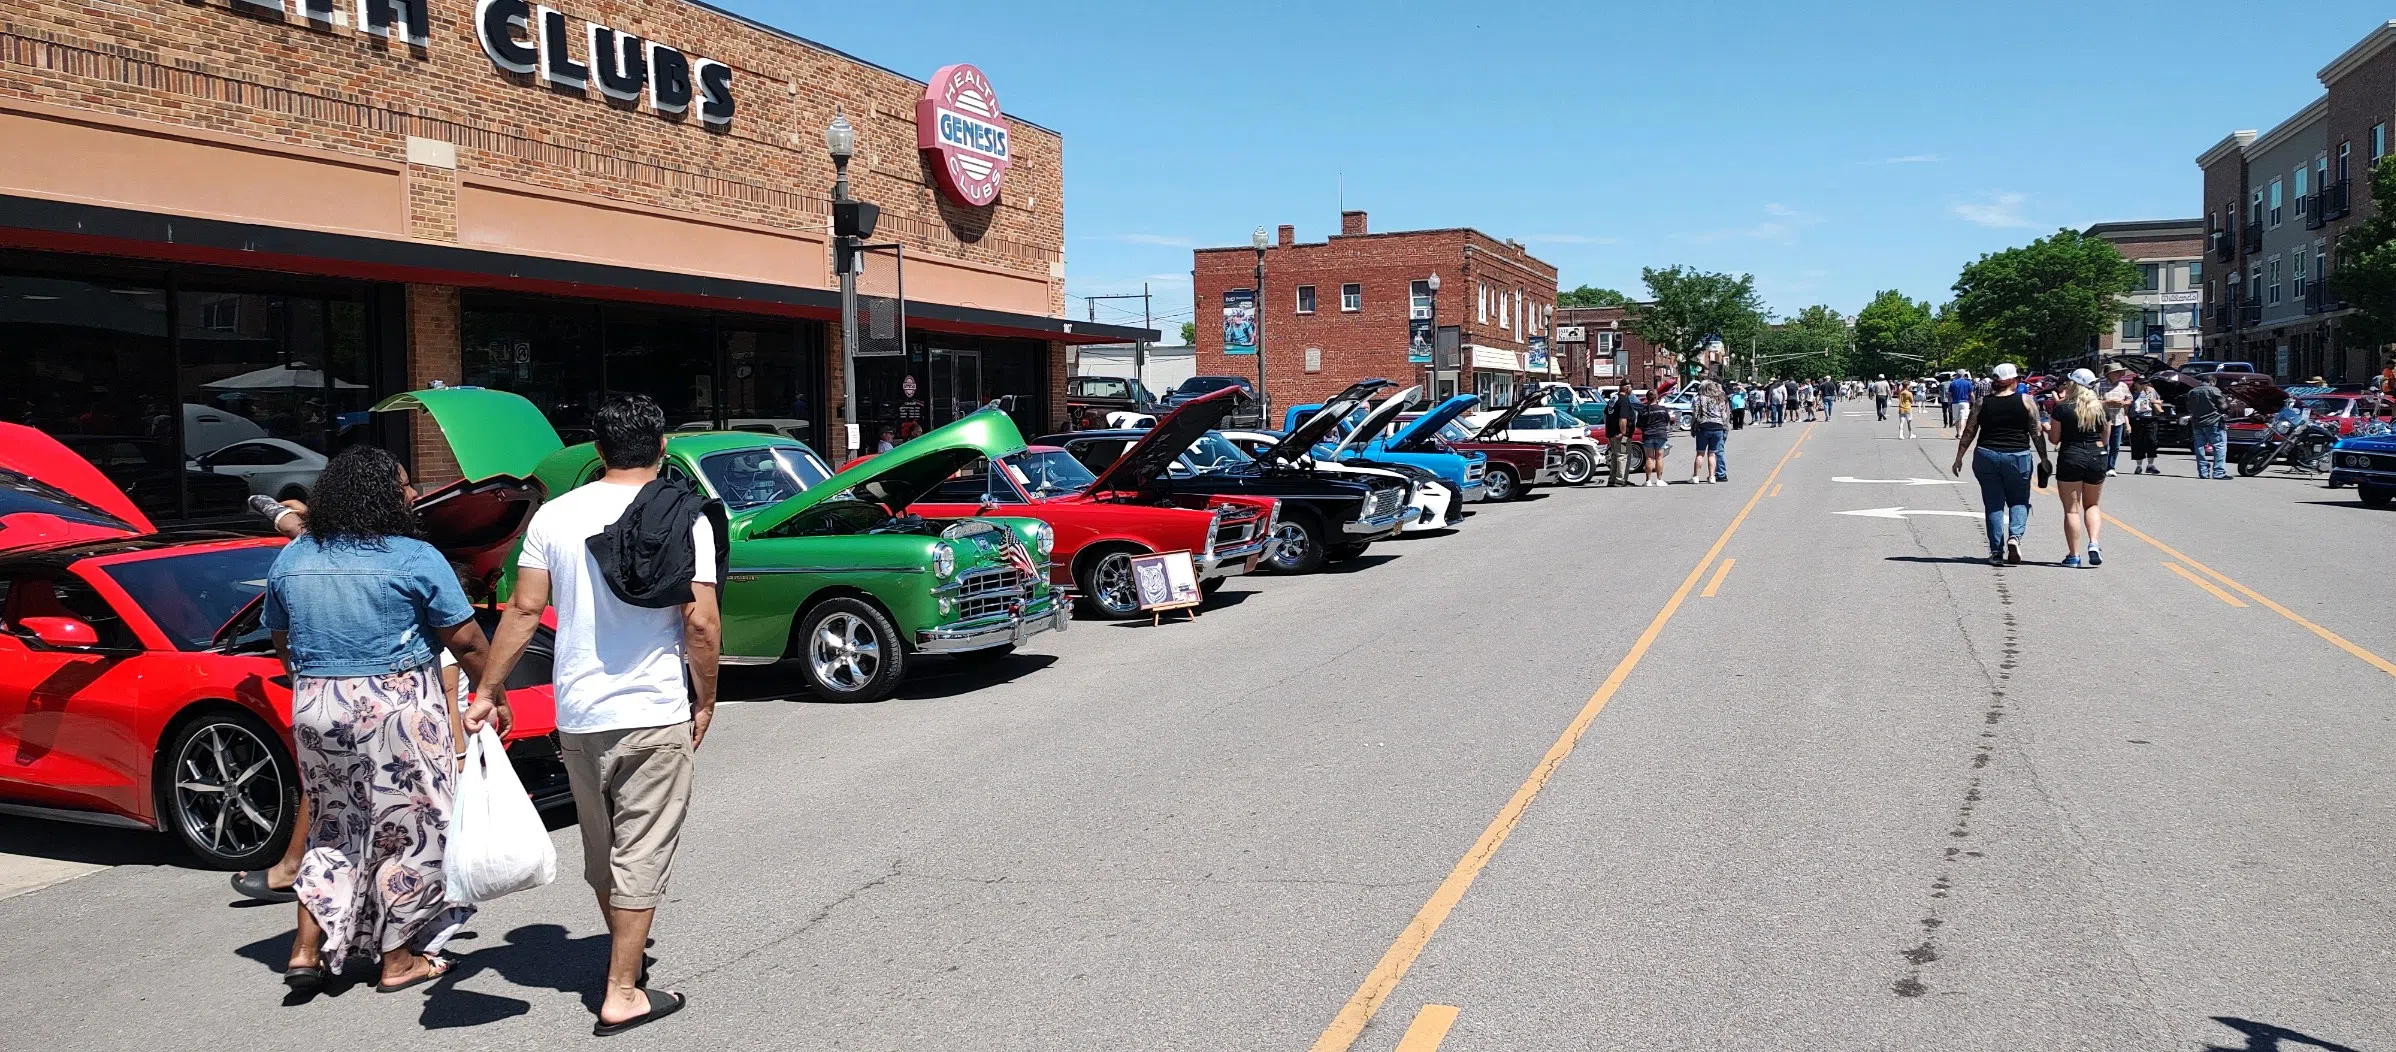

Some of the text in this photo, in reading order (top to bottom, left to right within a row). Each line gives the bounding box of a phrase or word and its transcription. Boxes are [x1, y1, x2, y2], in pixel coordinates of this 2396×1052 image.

[476, 0, 736, 125] CLUBS
[945, 70, 999, 119] HEALTH
[940, 113, 1006, 157] GENESIS
[949, 156, 1001, 200] CLUBS
